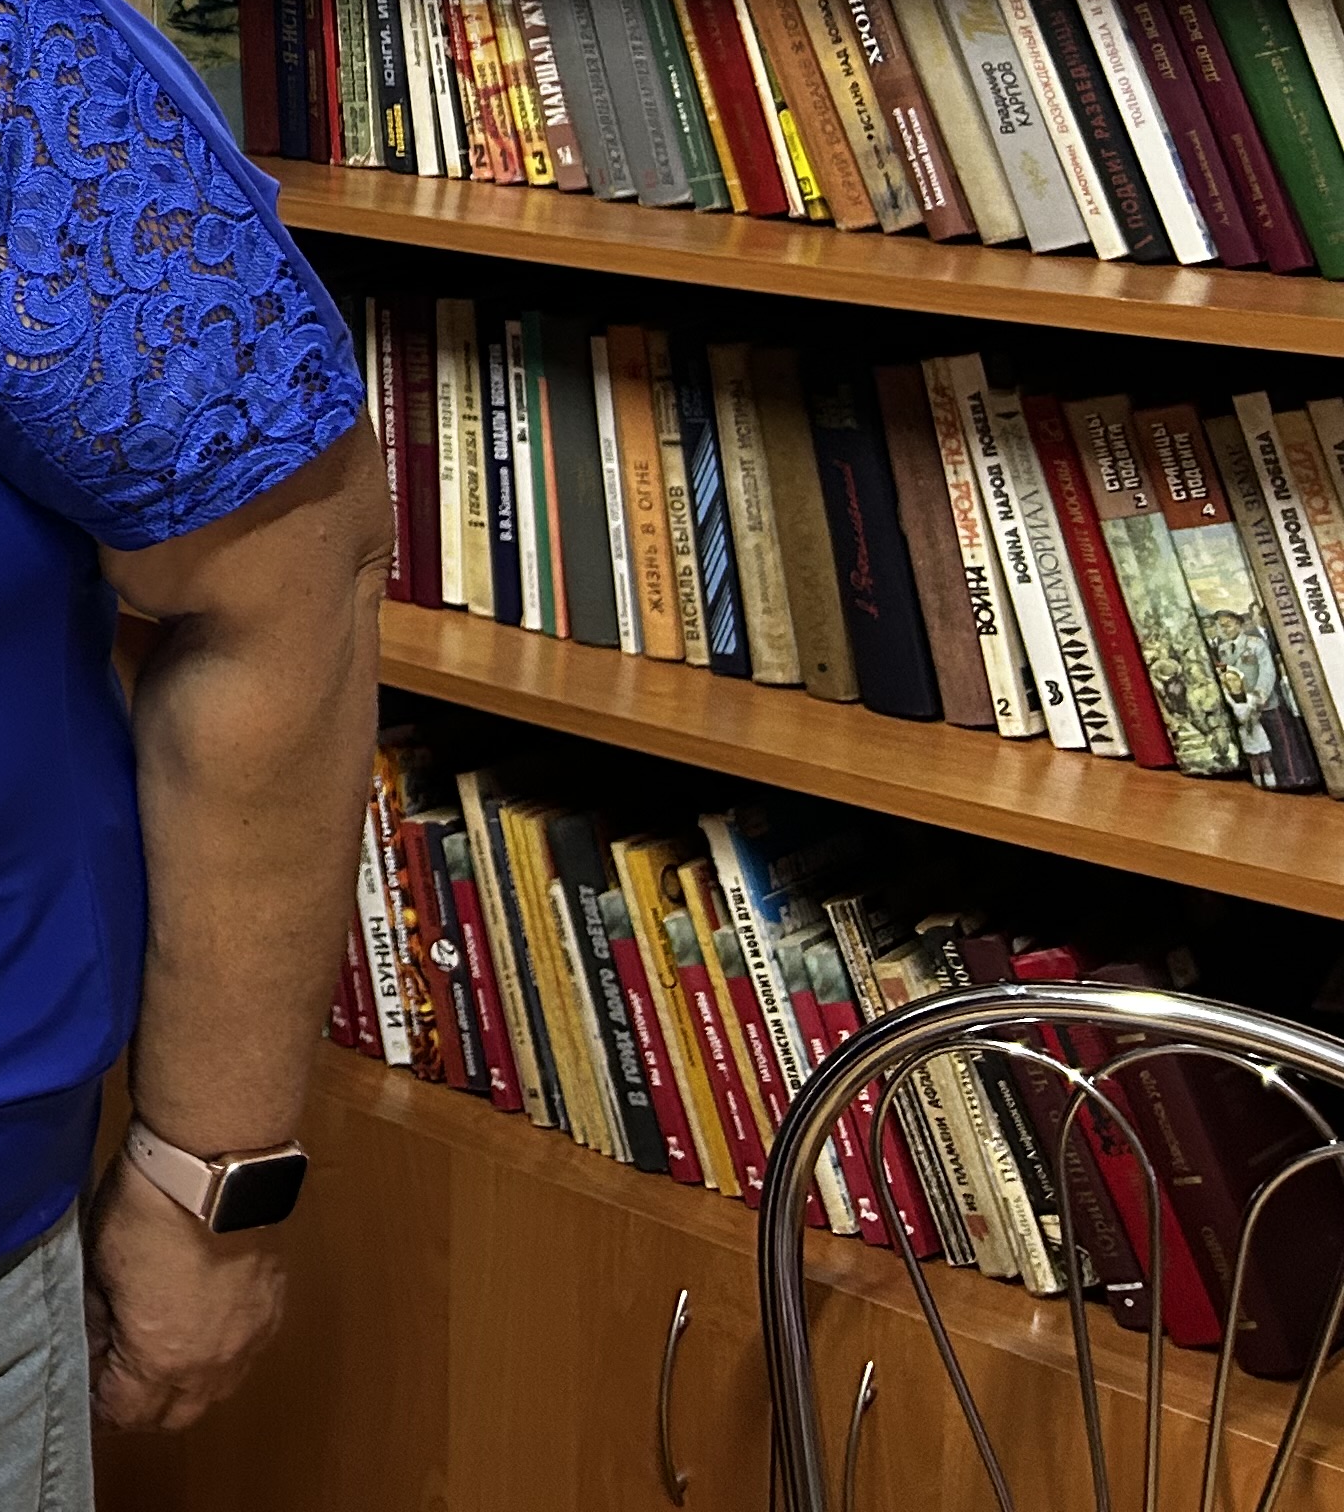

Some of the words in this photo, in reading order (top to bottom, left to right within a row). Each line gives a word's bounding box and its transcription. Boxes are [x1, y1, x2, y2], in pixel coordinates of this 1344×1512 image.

[528, 35, 570, 126] МАРШАЛ
[836, 48, 854, 77] НАД
[997, 61, 1033, 127] КАРПОВ
[848, 81, 874, 132] ВСТАНЬ
[981, 62, 1014, 134] Владимир
[967, 391, 998, 457] ПОБЕДА
[1086, 414, 1120, 491] СТРАНИЦЫ
[1108, 423, 1140, 488] ПОДВИГА
[634, 460, 653, 511] ОГНЕ
[987, 463, 1015, 520] НАРОД
[1151, 423, 1187, 501] СТРАНИЦЫ
[1174, 432, 1207, 498] ПОДВИГА
[1255, 430, 1292, 501] ПОБЕДА
[640, 523, 655, 535] В
[669, 485, 691, 556] БЫКОВ
[950, 481, 981, 548] НАРОД
[1282, 507, 1313, 567] НАРОД
[644, 535, 666, 615] ЖИЗНЬ
[1019, 489, 1077, 625] МЕМОРИАЛ
[676, 565, 700, 641] ВАСИЛЬ
[369, 916, 397, 997] БУНИЧ
[756, 973, 779, 1013] БОЛИТ
